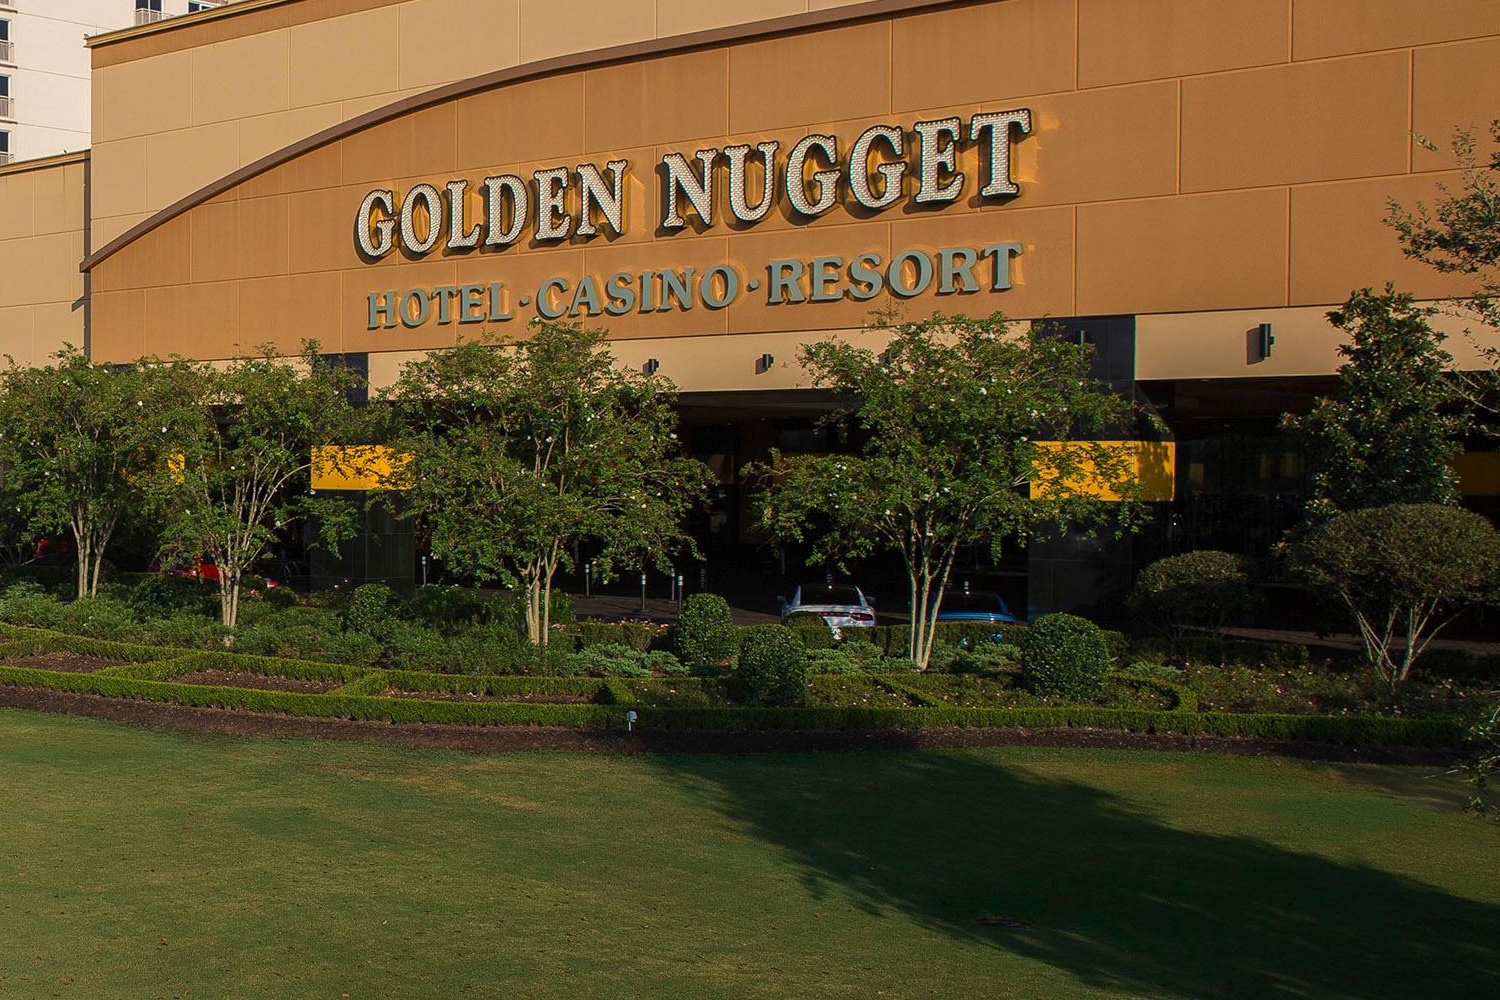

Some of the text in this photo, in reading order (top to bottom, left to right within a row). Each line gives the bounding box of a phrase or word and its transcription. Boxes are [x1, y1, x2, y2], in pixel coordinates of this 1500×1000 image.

[356, 107, 1032, 257] GOLDEN NUGGET
[368, 243, 1023, 329] HOTEL CASINO RESORT
